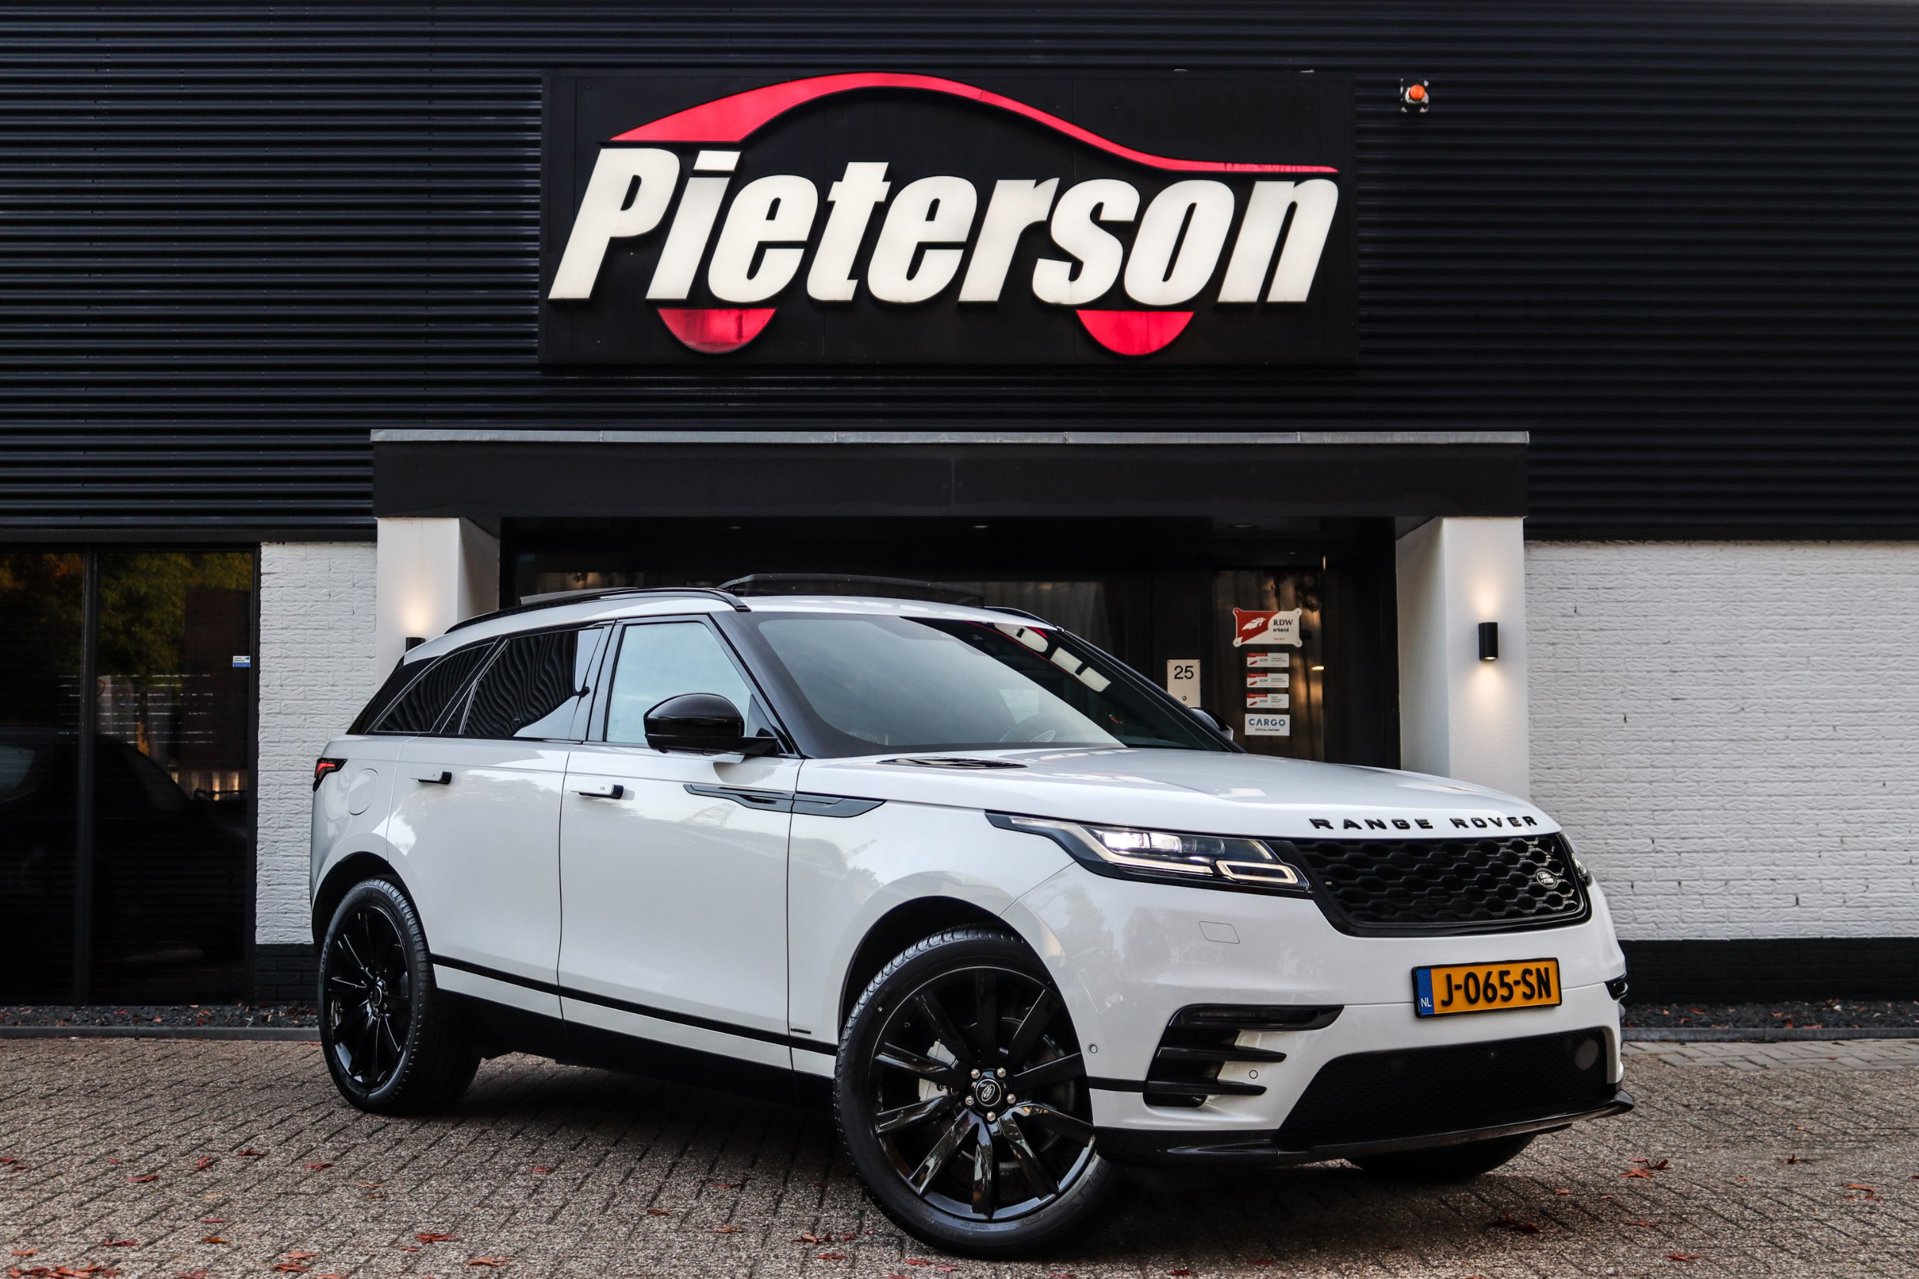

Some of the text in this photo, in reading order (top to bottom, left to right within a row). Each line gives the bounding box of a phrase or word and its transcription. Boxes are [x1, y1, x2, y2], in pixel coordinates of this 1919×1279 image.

[548, 146, 1340, 307] Pieterson
[1273, 618, 1294, 626] RDW
[1174, 665, 1194, 680] 25
[1248, 718, 1286, 727] CARGO
[1309, 815, 1539, 830] RANGE ROVER
[1441, 967, 1552, 1007] J-065-SN
[1420, 997, 1433, 1008] NL
